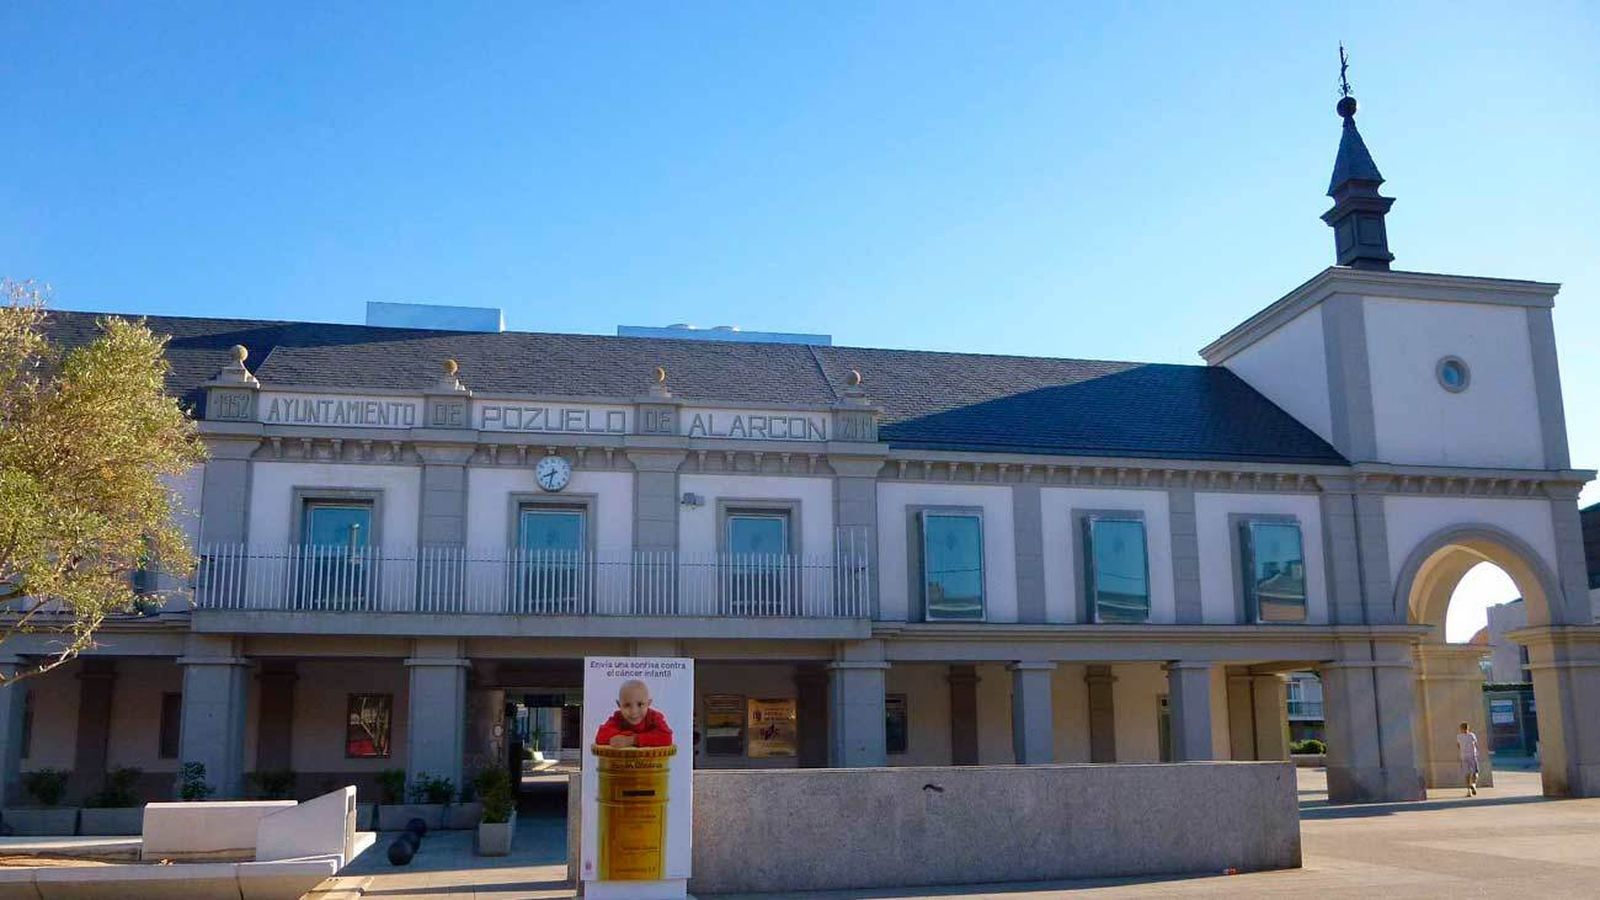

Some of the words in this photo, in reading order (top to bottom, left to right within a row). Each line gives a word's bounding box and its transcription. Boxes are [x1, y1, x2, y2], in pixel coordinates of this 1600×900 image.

[268, 398, 415, 425] AYUNTAMIENTO
[432, 403, 463, 426] DE
[481, 405, 627, 433] POZUELO
[645, 410, 672, 433] DE
[689, 412, 827, 440] ALARCON
[614, 661, 628, 669] una
[631, 661, 660, 669] sonrisa
[660, 661, 686, 670] contra
[615, 669, 642, 677] cáncer
